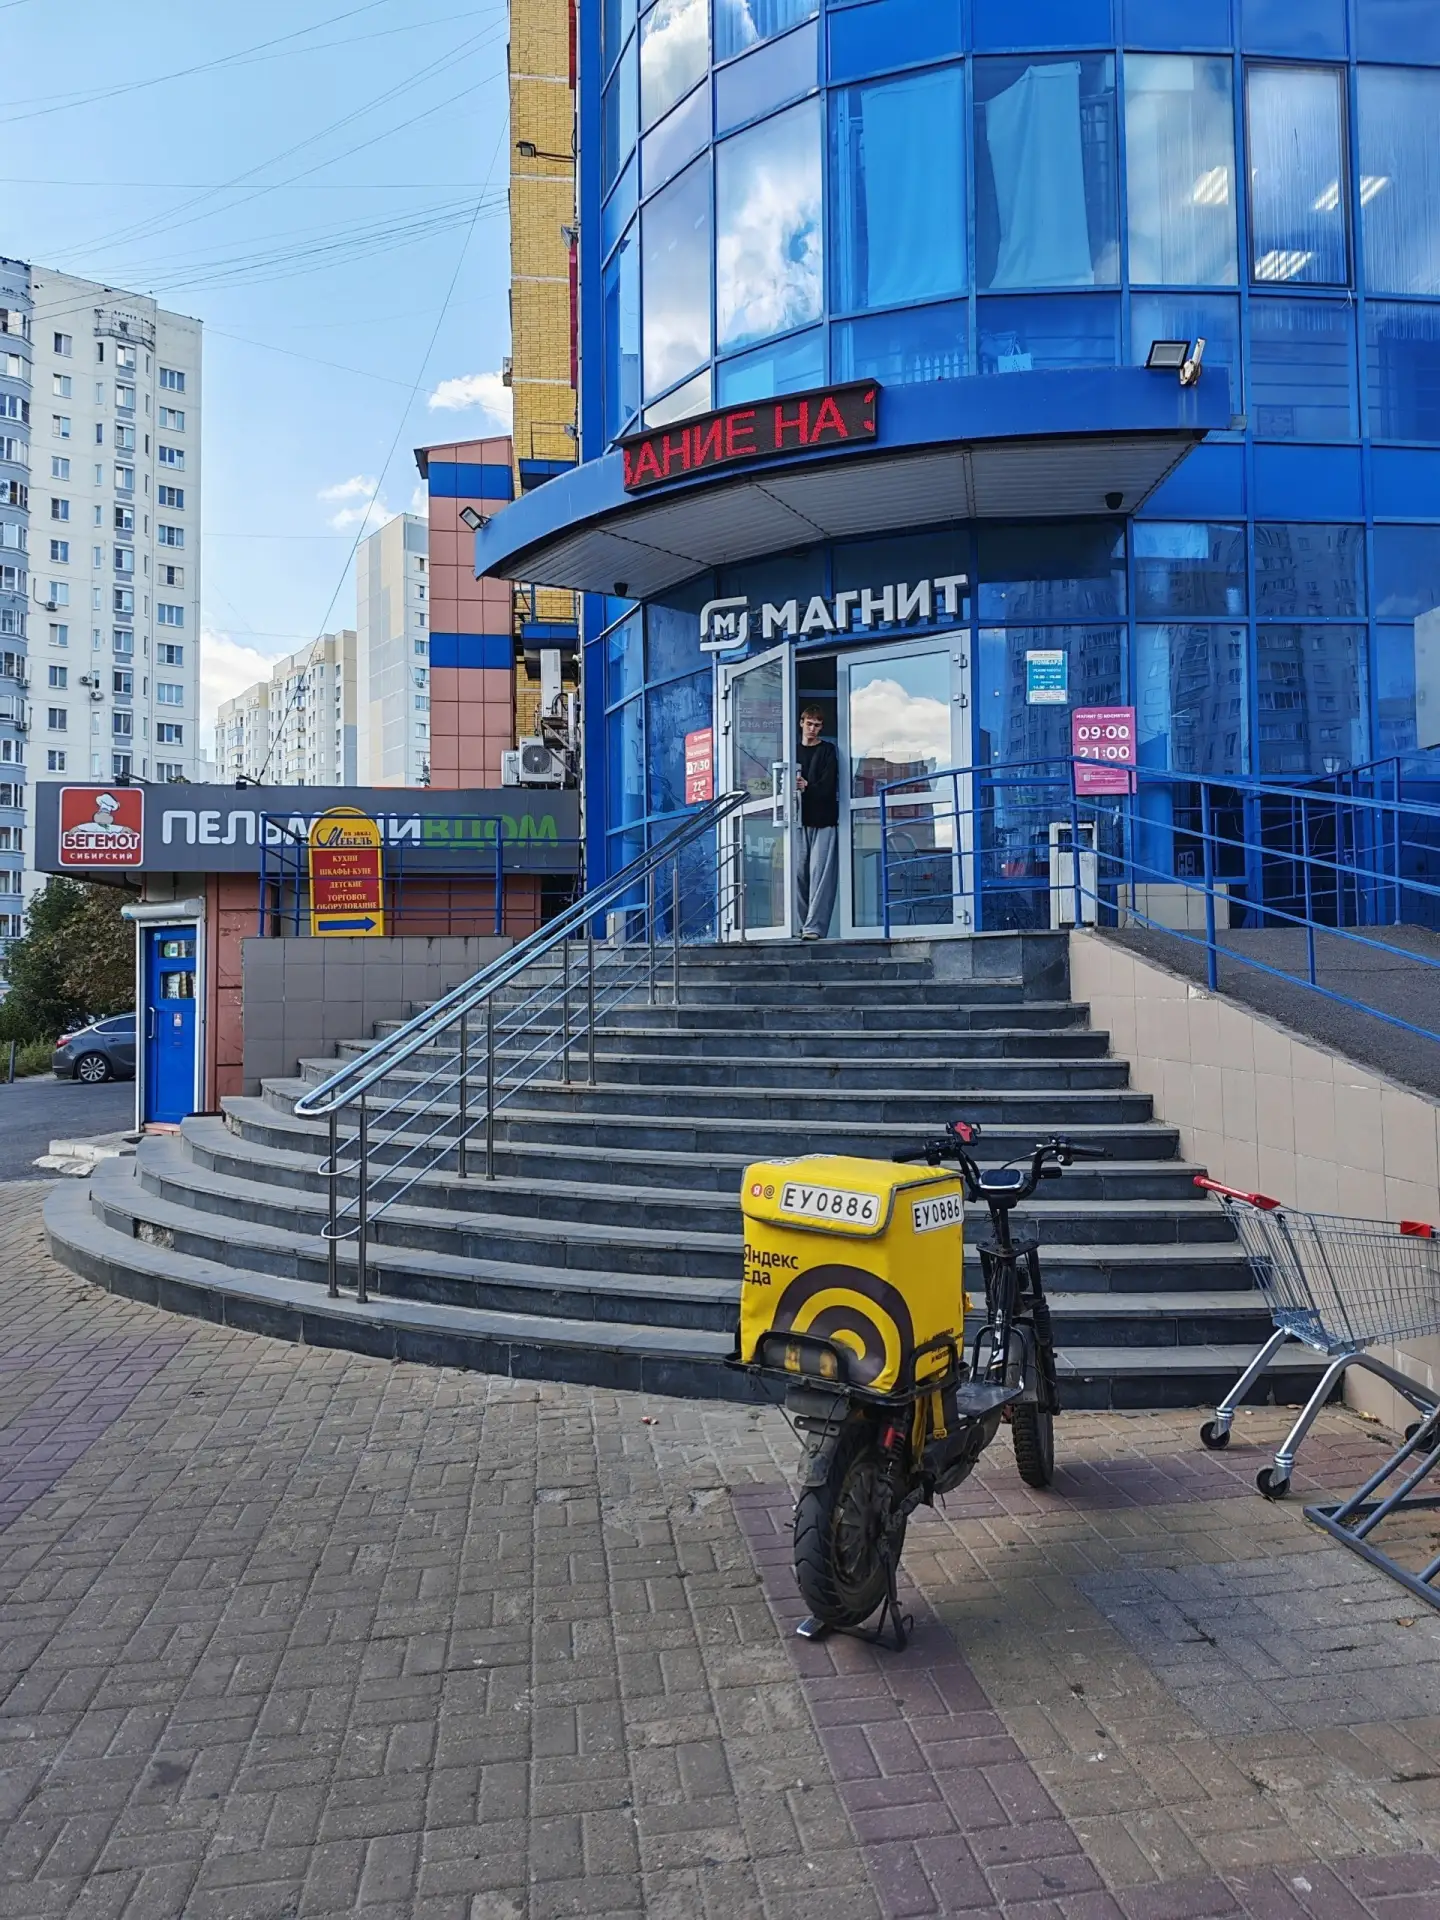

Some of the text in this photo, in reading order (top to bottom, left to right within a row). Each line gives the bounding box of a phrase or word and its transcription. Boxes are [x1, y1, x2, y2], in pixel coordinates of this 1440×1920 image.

[774, 396, 848, 449] НА
[762, 573, 969, 639] МАГНИТ
[1078, 725, 1130, 740] 09:00
[1079, 745, 1130, 760] 21:00
[63, 832, 139, 849] БЕГЕМОТ
[69, 852, 133, 861] СИБИРСКИЙ
[332, 854, 359, 862] КУХНИ
[319, 867, 372, 876] ШКАФЫ-КУПЕ
[329, 880, 363, 889] ДЕТСКИЕ
[327, 893, 368, 902] ТОРГОВОЕ
[316, 901, 378, 910] ОБОРУДОВАНИЕ
[783, 1187, 873, 1220] ЕУ0886
[914, 1198, 961, 1229] ЕУ0886
[744, 1243, 799, 1270] Яндекс
